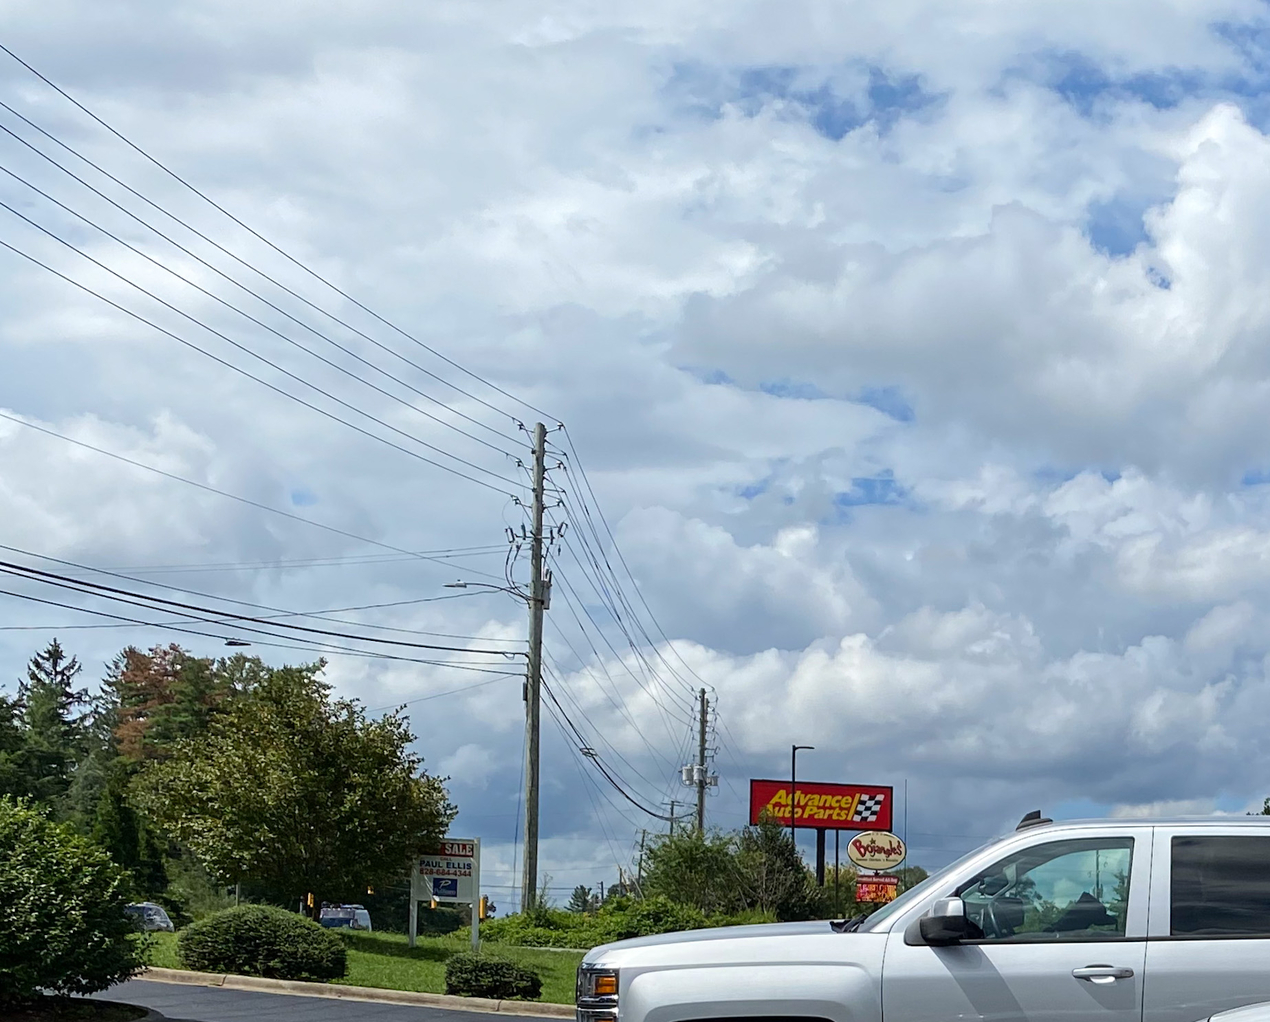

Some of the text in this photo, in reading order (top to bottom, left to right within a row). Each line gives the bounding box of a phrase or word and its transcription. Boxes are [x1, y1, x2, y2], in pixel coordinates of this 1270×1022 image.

[769, 789, 851, 806] Advance
[766, 804, 848, 820] Auto Parts
[444, 843, 473, 855] SALE
[446, 862, 472, 870] ELLIS
